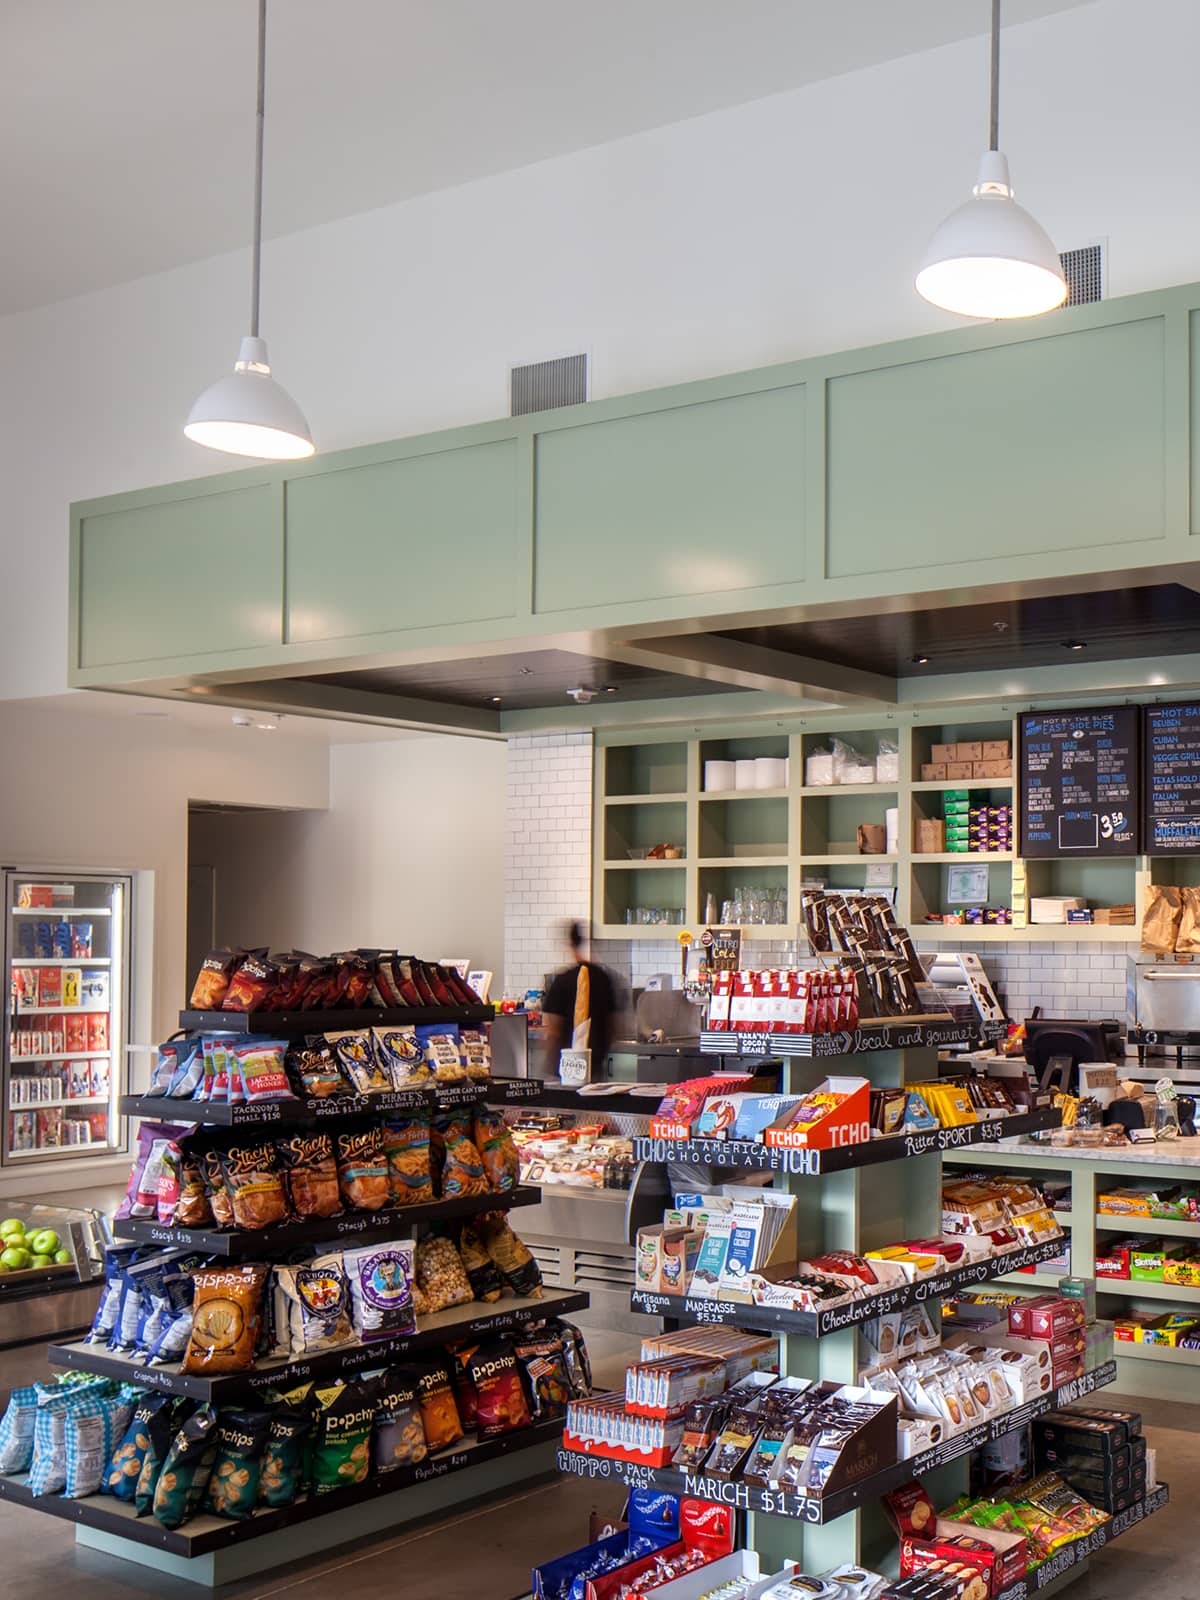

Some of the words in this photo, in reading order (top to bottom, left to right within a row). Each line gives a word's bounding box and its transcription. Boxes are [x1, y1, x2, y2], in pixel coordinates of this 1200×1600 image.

[1160, 709, 1182, 718] HOT
[1043, 723, 1066, 735] EAST
[1070, 721, 1091, 731] SIDE
[1093, 720, 1115, 731] PIES
[1153, 719, 1181, 728] REUBEN
[1153, 736, 1178, 744] CUBAN
[1153, 753, 1179, 761] VEGGIE
[1153, 776, 1175, 784] TEXAS
[1176, 775, 1197, 783] HOLD
[1153, 792, 1178, 800] ITALIAN
[853, 1025, 893, 1054] local
[898, 1028, 923, 1046] and
[926, 1025, 978, 1048] gourmet
[815, 1048, 841, 1056] STUDIO
[381, 1091, 424, 1103] PIRATE'S
[435, 1087, 461, 1097] BOULDER
[462, 1085, 488, 1095] CANYON
[306, 1095, 369, 1110] STACY'S
[440, 1095, 460, 1105] SMALL
[758, 1099, 780, 1110] TCHO
[233, 1104, 281, 1115] JACKSON'S
[316, 1106, 341, 1116] SMALL
[375, 1103, 394, 1112] SMALL
[233, 1115, 260, 1125] SMALL
[262, 1112, 282, 1123] $1.50
[769, 1131, 802, 1146] TCHO
[829, 1121, 870, 1148] TCHO
[905, 1134, 935, 1157] Ritter
[938, 1125, 976, 1149] SPORT
[338, 1127, 382, 1160] Stacy's
[227, 1141, 276, 1177] Stacy's
[634, 1138, 666, 1163] TCHO
[667, 1140, 702, 1151] NEW
[703, 1142, 779, 1158] AMERICAN
[781, 1149, 820, 1176] TCHO
[667, 1152, 779, 1168] CHOCOLATE
[337, 1221, 367, 1233] Stacy's
[151, 1229, 174, 1241] Stacy's
[997, 1248, 1042, 1275] Chocolove
[1133, 1257, 1162, 1267] Skittles
[958, 1269, 976, 1282] $1.50
[632, 1291, 671, 1306] Artisana
[645, 1303, 659, 1314] $2
[685, 1297, 736, 1314] MADÉCASSE
[697, 1312, 724, 1323] $5.25
[821, 1305, 871, 1332] Chocolove
[342, 1351, 367, 1366] Pirates
[134, 1370, 158, 1385] Crisproot
[415, 1463, 448, 1480] Popchips
[615, 1460, 623, 1472] 5
[626, 1463, 656, 1482] PACK
[623, 1476, 648, 1489] $4.95
[684, 1474, 750, 1509] MARICH
[761, 1490, 820, 1522] $1.75
[1037, 1545, 1075, 1588] HARIBO
